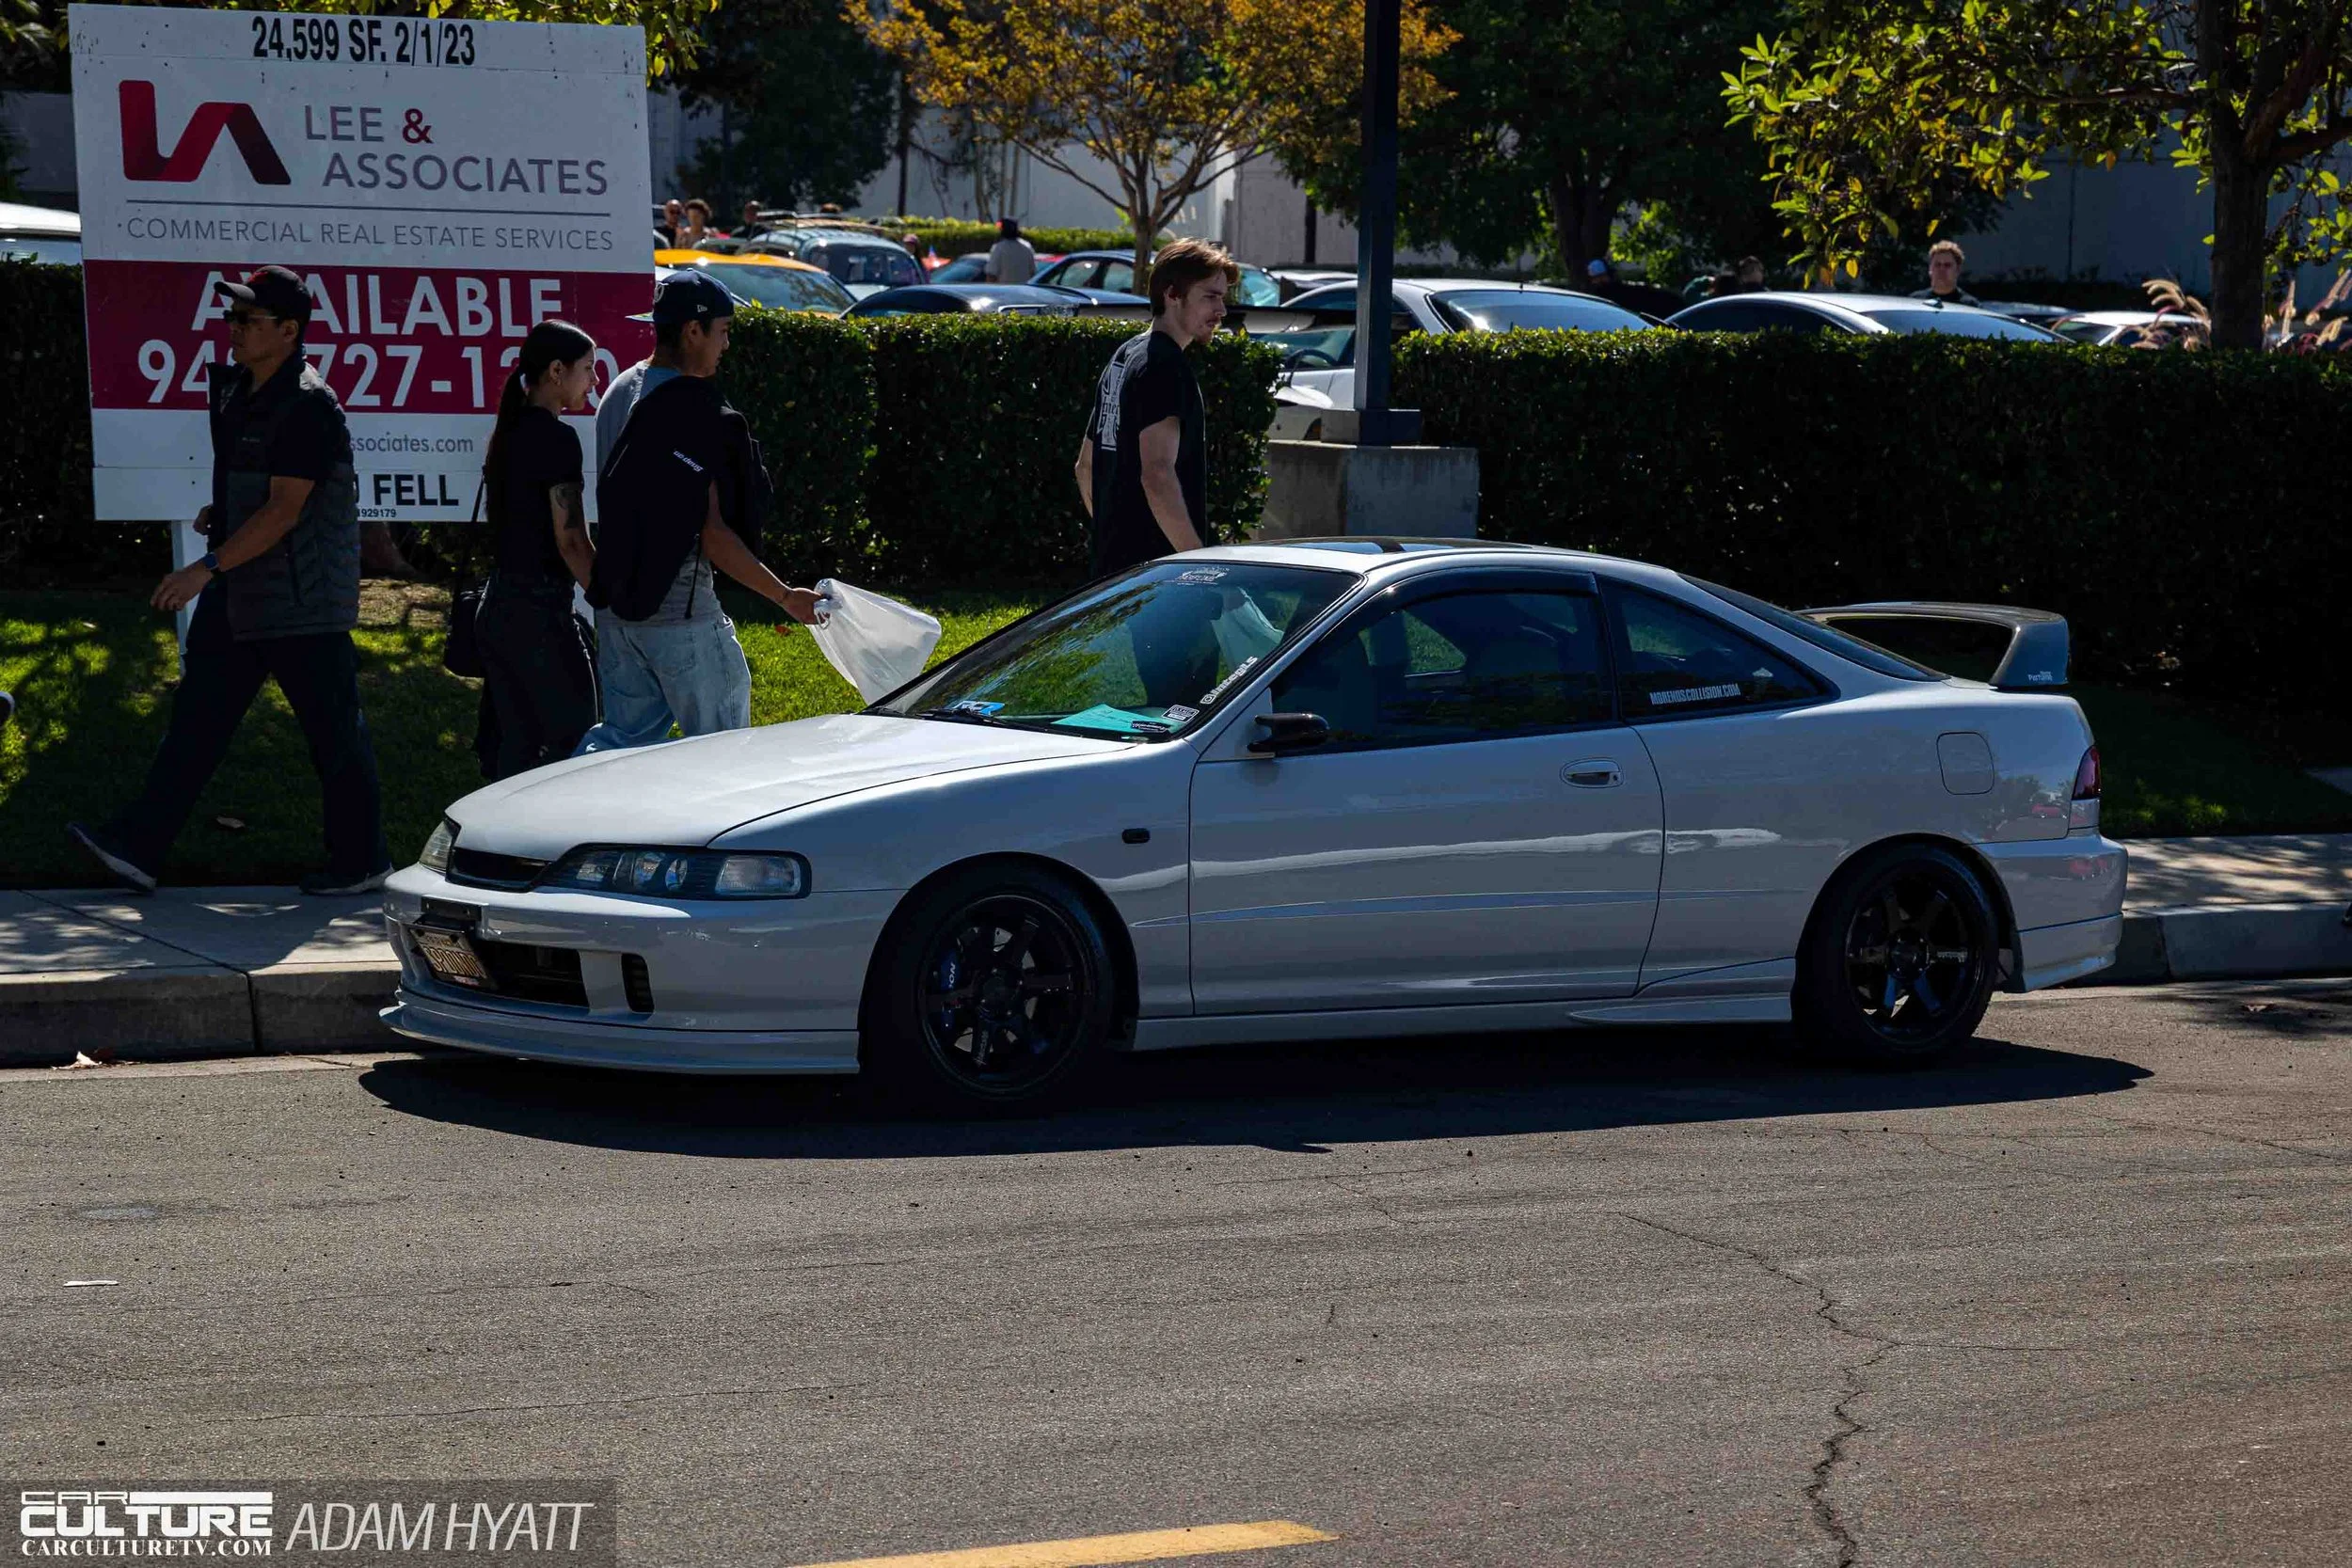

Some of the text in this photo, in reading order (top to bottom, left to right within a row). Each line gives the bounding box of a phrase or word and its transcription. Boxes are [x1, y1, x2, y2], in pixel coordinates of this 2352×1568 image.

[252, 16, 340, 61] 24,599
[395, 22, 475, 66] 2/1/23
[305, 105, 434, 144] LEE &
[322, 151, 610, 196] ASSOCIATES
[127, 217, 613, 251] COMMERCIAL REAL ESTATE SERVICES
[191, 271, 562, 338] AAILABLE
[350, 431, 474, 452] ssociates.com
[373, 473, 460, 506] FELL
